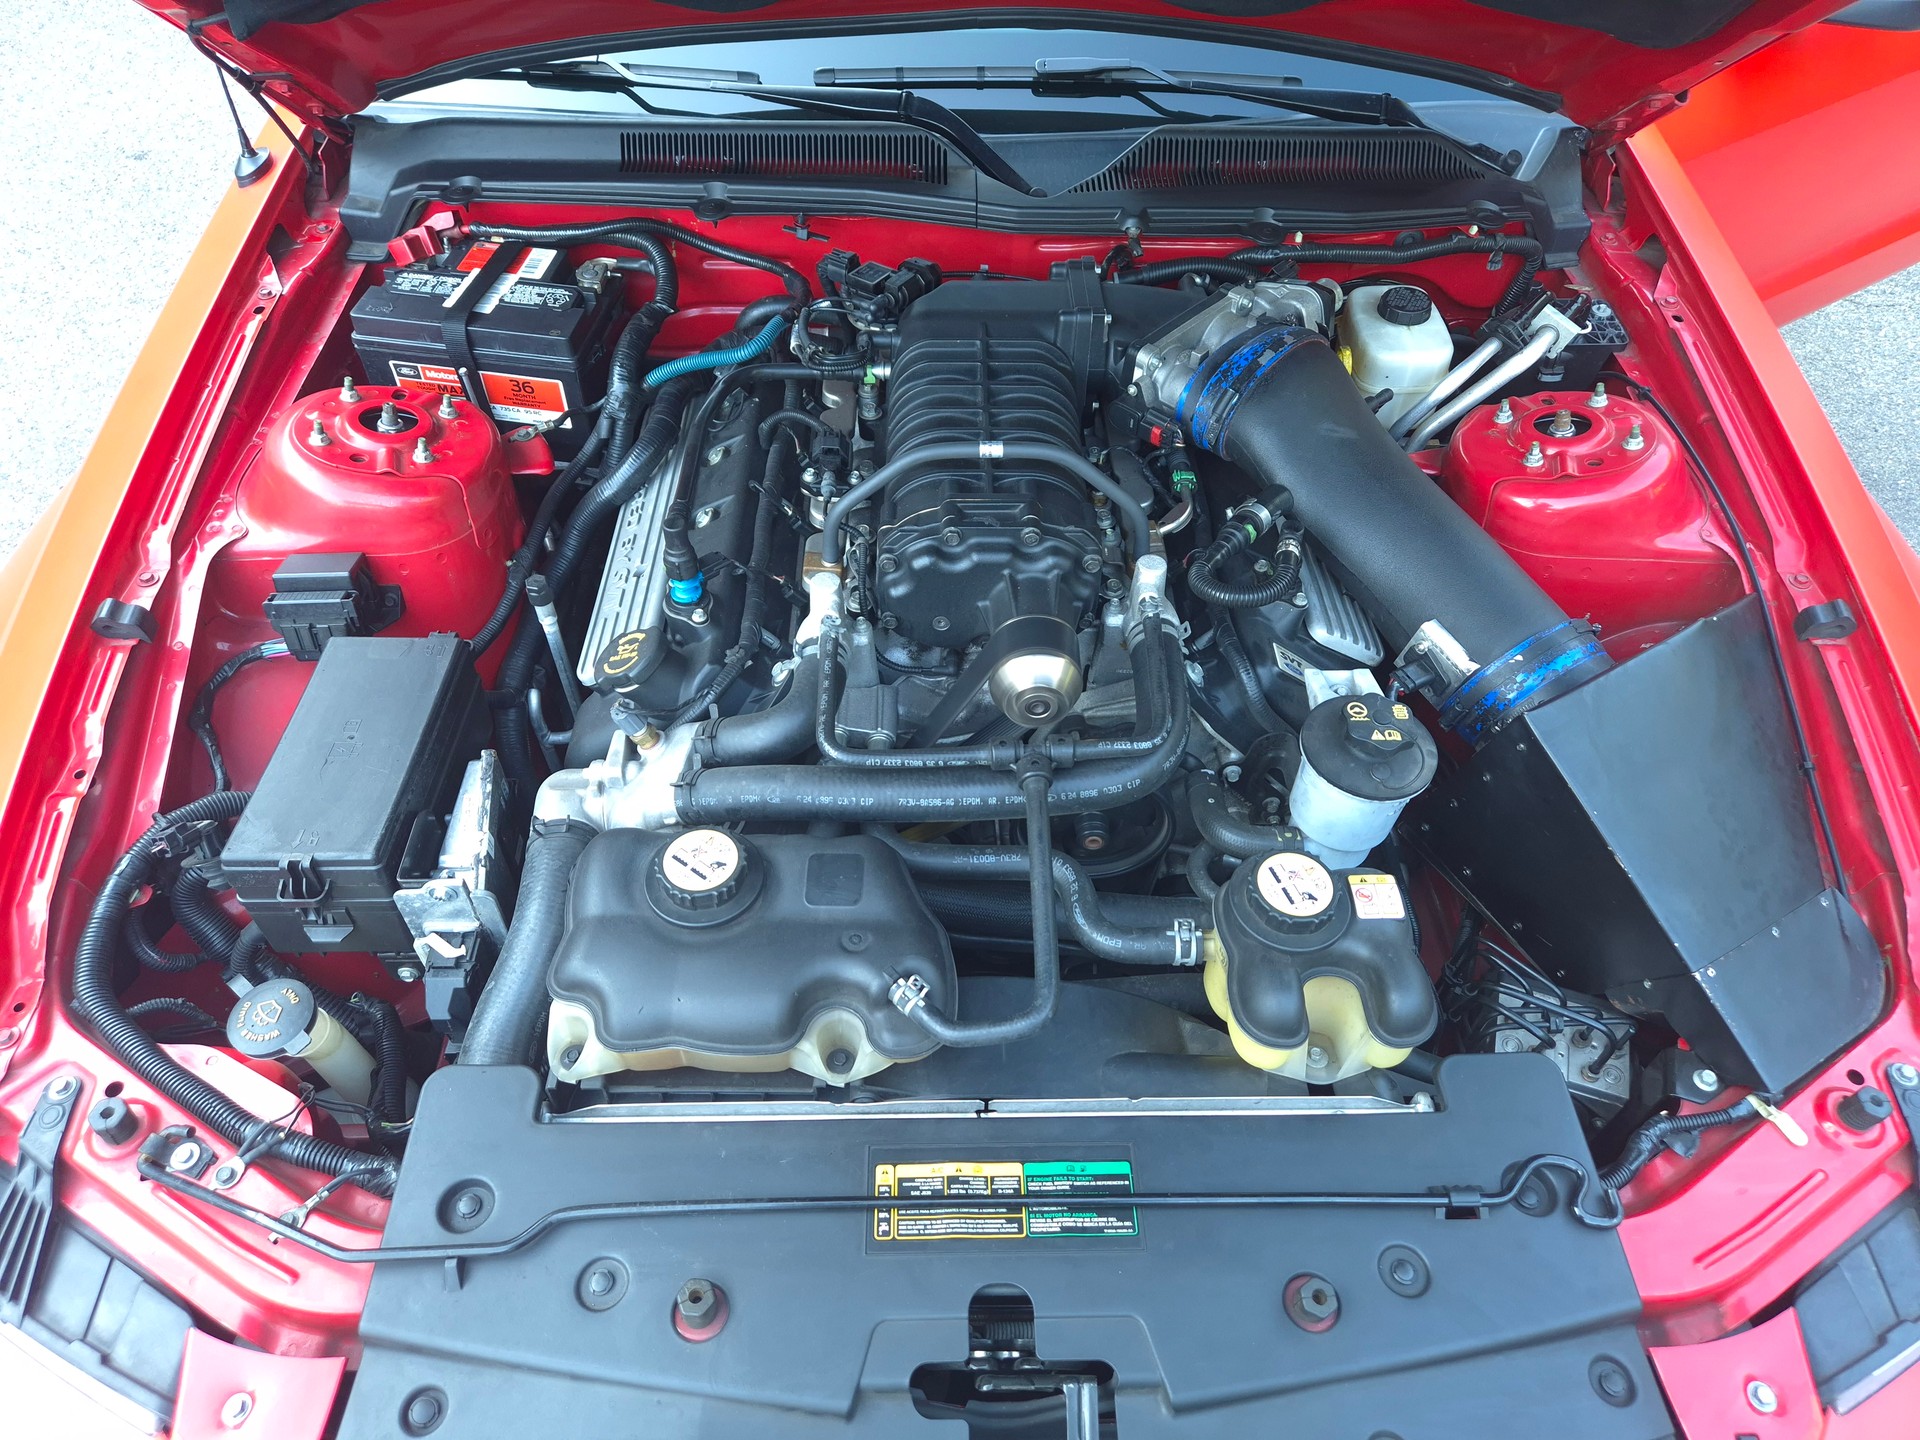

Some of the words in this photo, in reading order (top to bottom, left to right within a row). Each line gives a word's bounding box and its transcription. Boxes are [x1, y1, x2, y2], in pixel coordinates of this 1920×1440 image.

[509, 379, 535, 394] 36
[512, 392, 536, 400] MONTH
[1280, 651, 1303, 668] SVT
[860, 797, 874, 806] CIP
[1127, 778, 1141, 790] CIP
[280, 988, 300, 1004] ONLY
[236, 1002, 252, 1028] FLUID
[240, 1028, 281, 1042] WASHER
